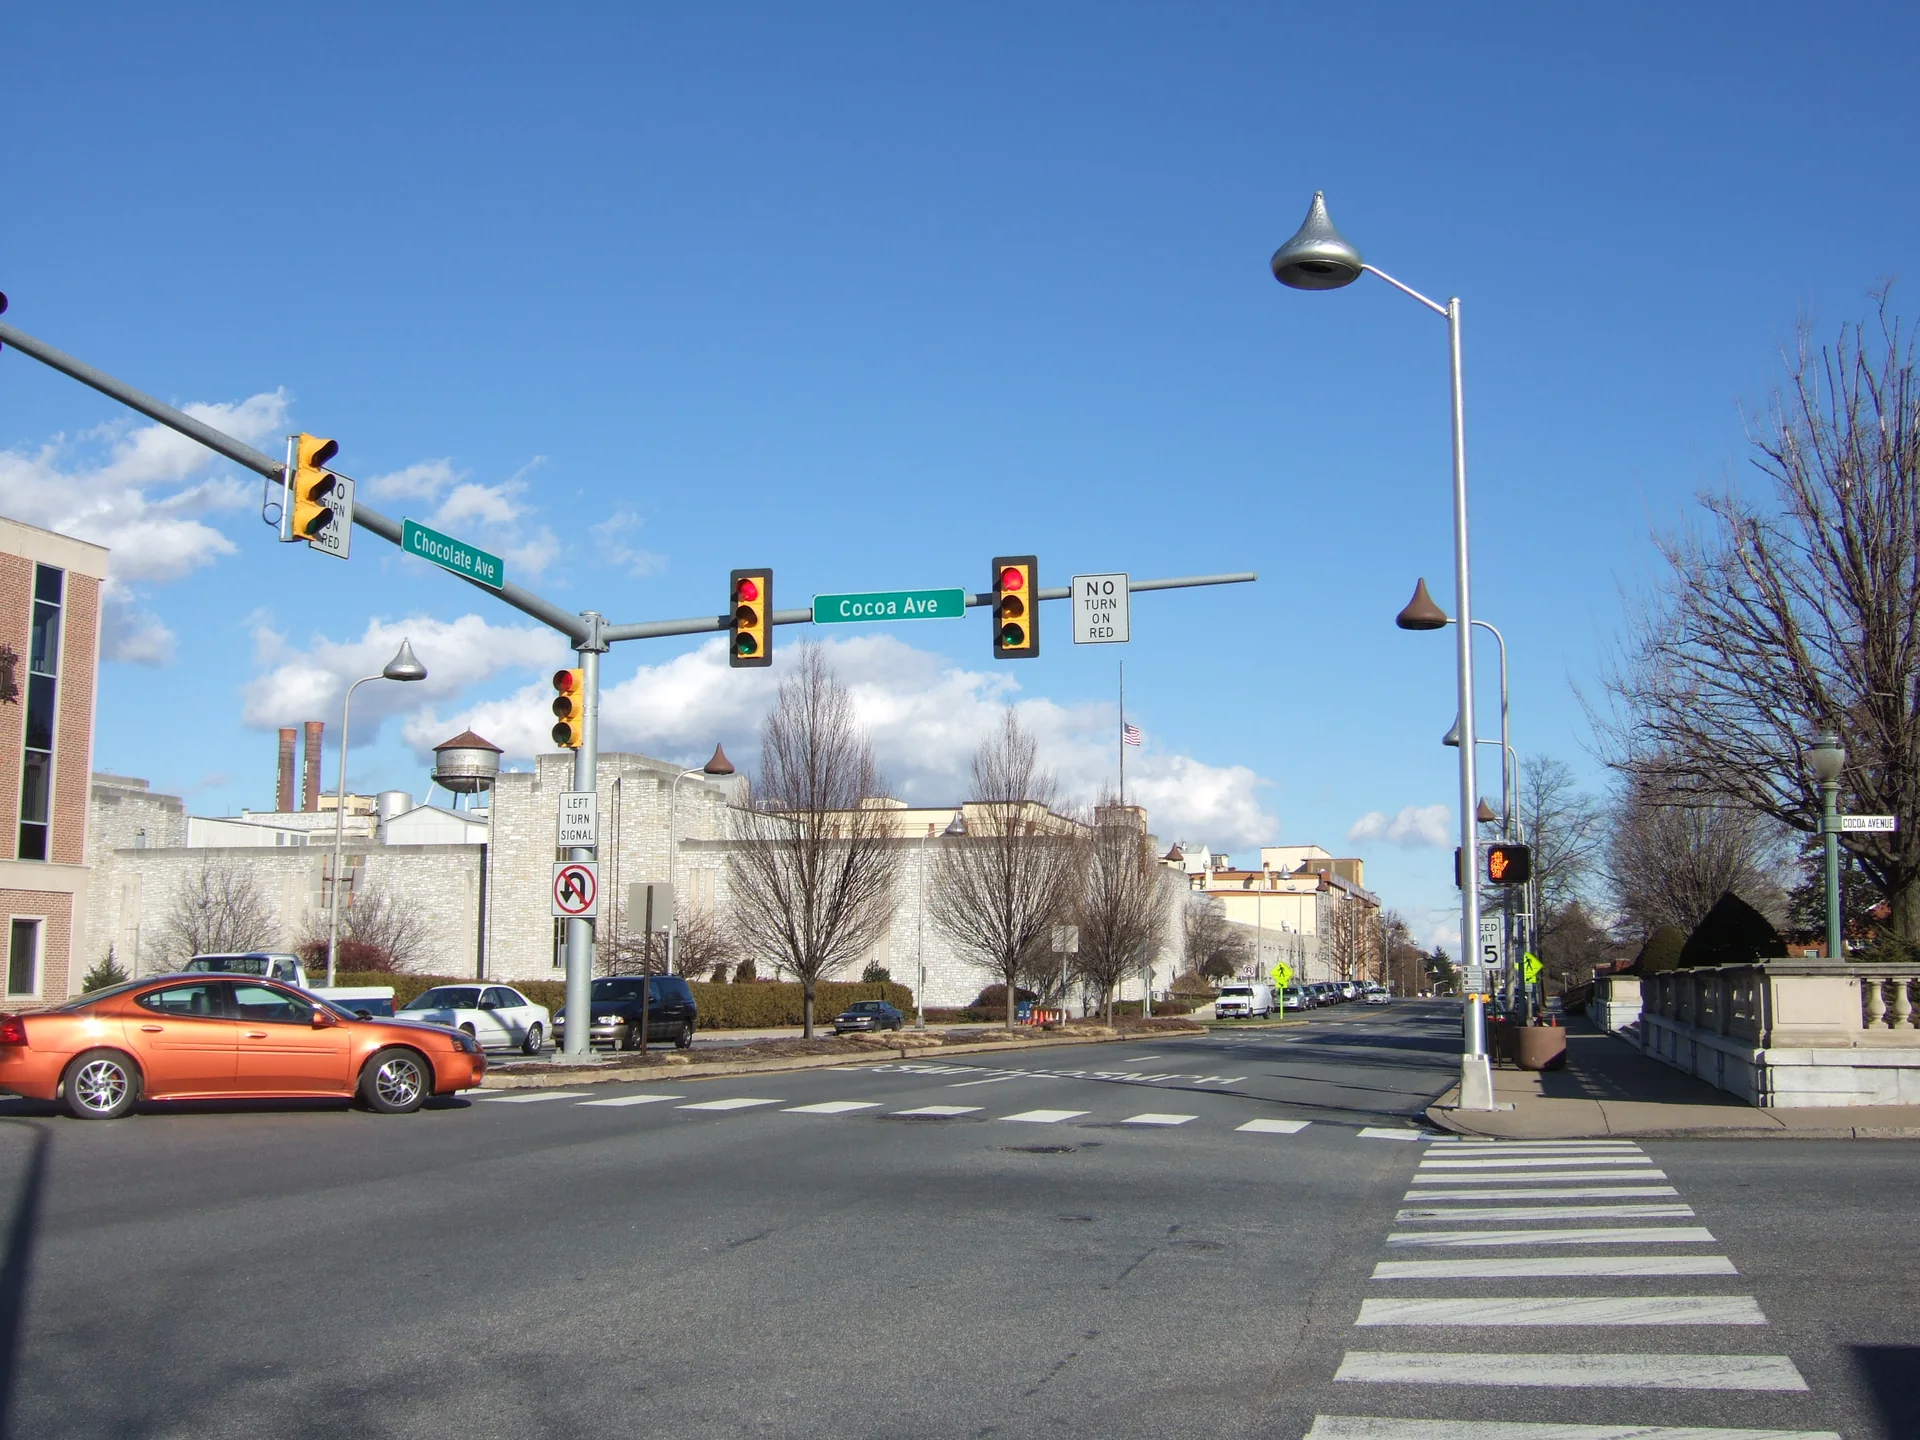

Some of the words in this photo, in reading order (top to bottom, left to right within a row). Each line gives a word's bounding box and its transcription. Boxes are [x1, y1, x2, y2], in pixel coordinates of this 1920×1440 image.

[323, 498, 345, 517] TURN
[322, 533, 340, 550] RED
[414, 530, 472, 570] Chocolate
[474, 556, 495, 579] Ave
[1087, 580, 1114, 596] NO
[840, 600, 897, 617] Cocoa
[903, 597, 938, 614] Ave
[1084, 598, 1117, 610] TURN
[1092, 613, 1110, 624] ON
[1089, 627, 1114, 638] RED
[567, 798, 588, 808] LEFT
[566, 814, 590, 824] TURN
[1843, 818, 1865, 828] COCOA
[1868, 818, 1893, 828] AVENUE
[561, 830, 593, 840] SIGNAL
[1480, 923, 1497, 931] EED
[1484, 945, 1498, 963] 5
